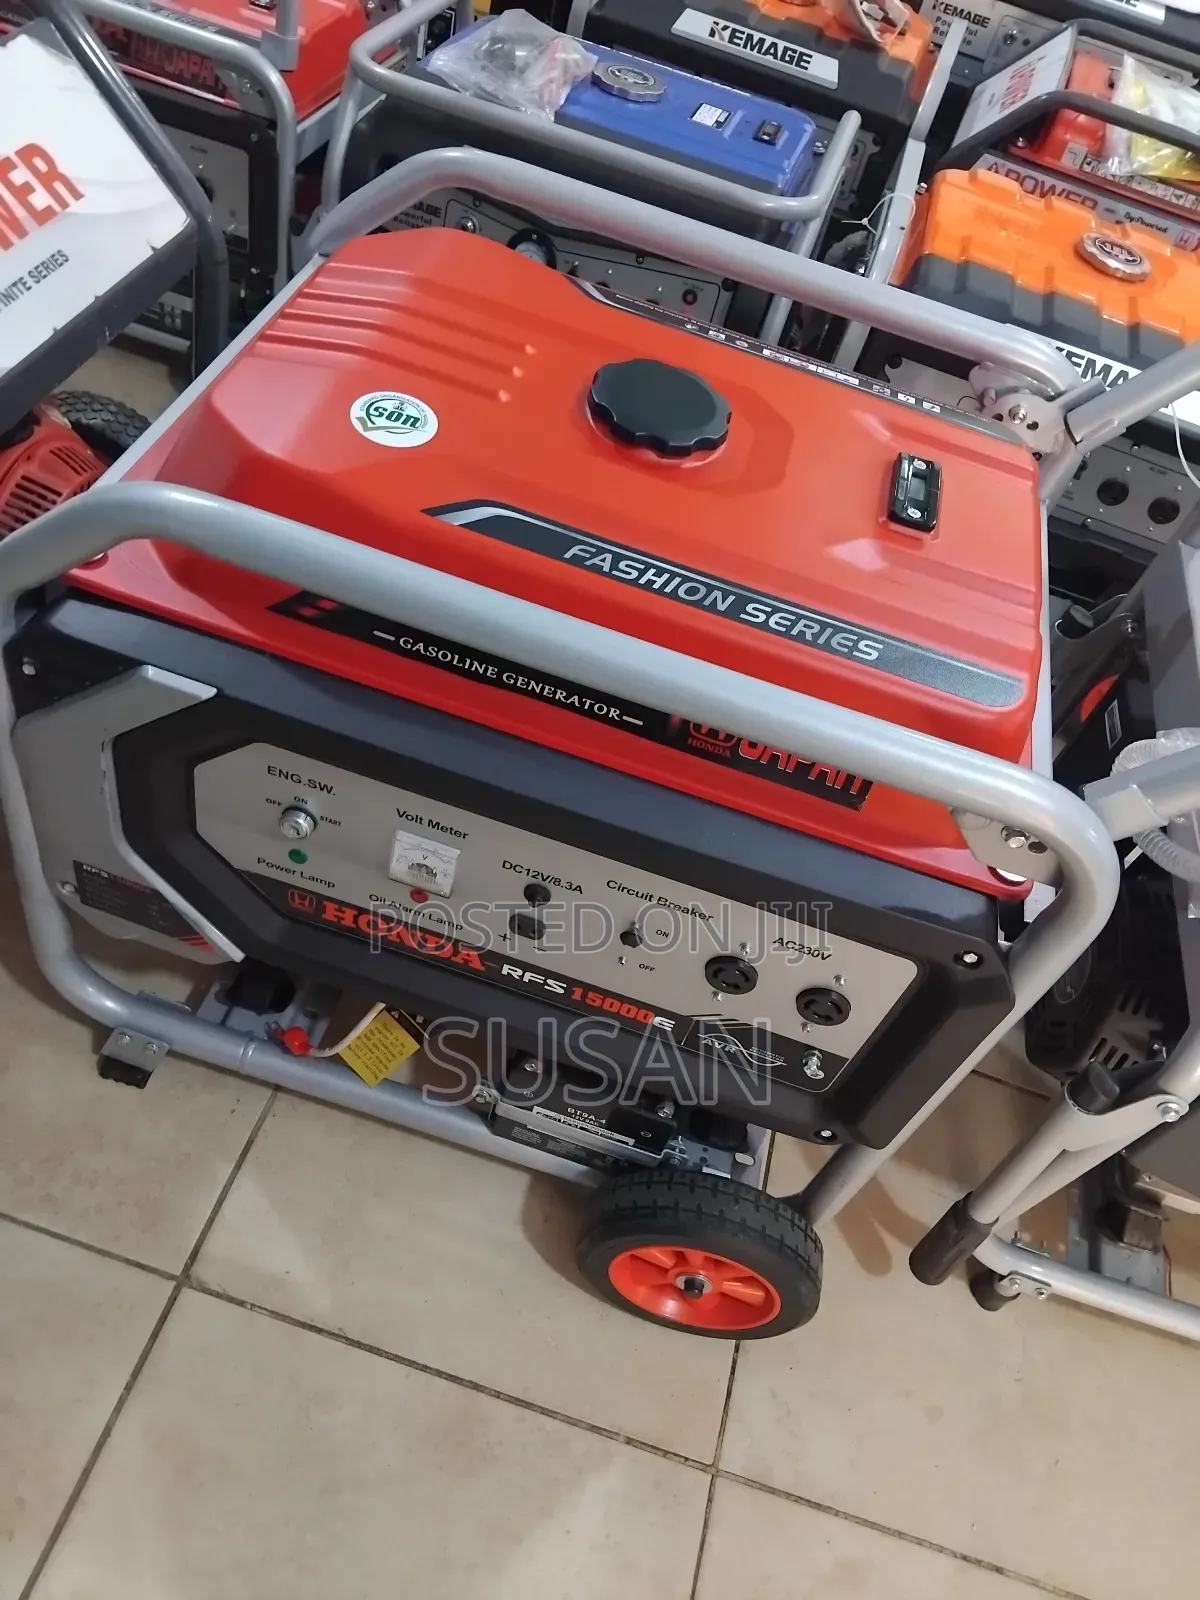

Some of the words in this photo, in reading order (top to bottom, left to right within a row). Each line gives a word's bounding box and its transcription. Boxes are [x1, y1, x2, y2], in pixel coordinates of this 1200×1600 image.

[708, 21, 813, 71] KEMAGE
[0, 276, 33, 313] INITE
[28, 249, 70, 284] SERIES
[563, 543, 736, 613] FASHION
[740, 602, 884, 663] SERIES
[400, 635, 498, 679] GASOLINE
[502, 671, 621, 721] GENERATOR
[687, 736, 732, 758] HONDA
[267, 764, 336, 796] ENG.SW.
[265, 797, 283, 807] OFF
[293, 795, 308, 805] ON
[319, 815, 342, 827] START
[396, 807, 424, 826] Volt
[427, 818, 469, 840] Meter
[256, 856, 297, 877] Power
[300, 870, 336, 889] Lamp
[501, 859, 584, 895] DC12V/8.3A
[369, 893, 387, 904] Oil
[388, 898, 427, 919] Alarm
[428, 911, 464, 932] Lamp
[606, 879, 655, 903] Circuit
[656, 896, 715, 924] Breaker
[655, 928, 670, 938] ON
[772, 936, 833, 962] AC230V
[323, 900, 486, 971] HONDA
[500, 962, 567, 996] RFS
[570, 986, 676, 1032] 15000E
[638, 962, 656, 973] OFF
[702, 1036, 738, 1054] AVR
